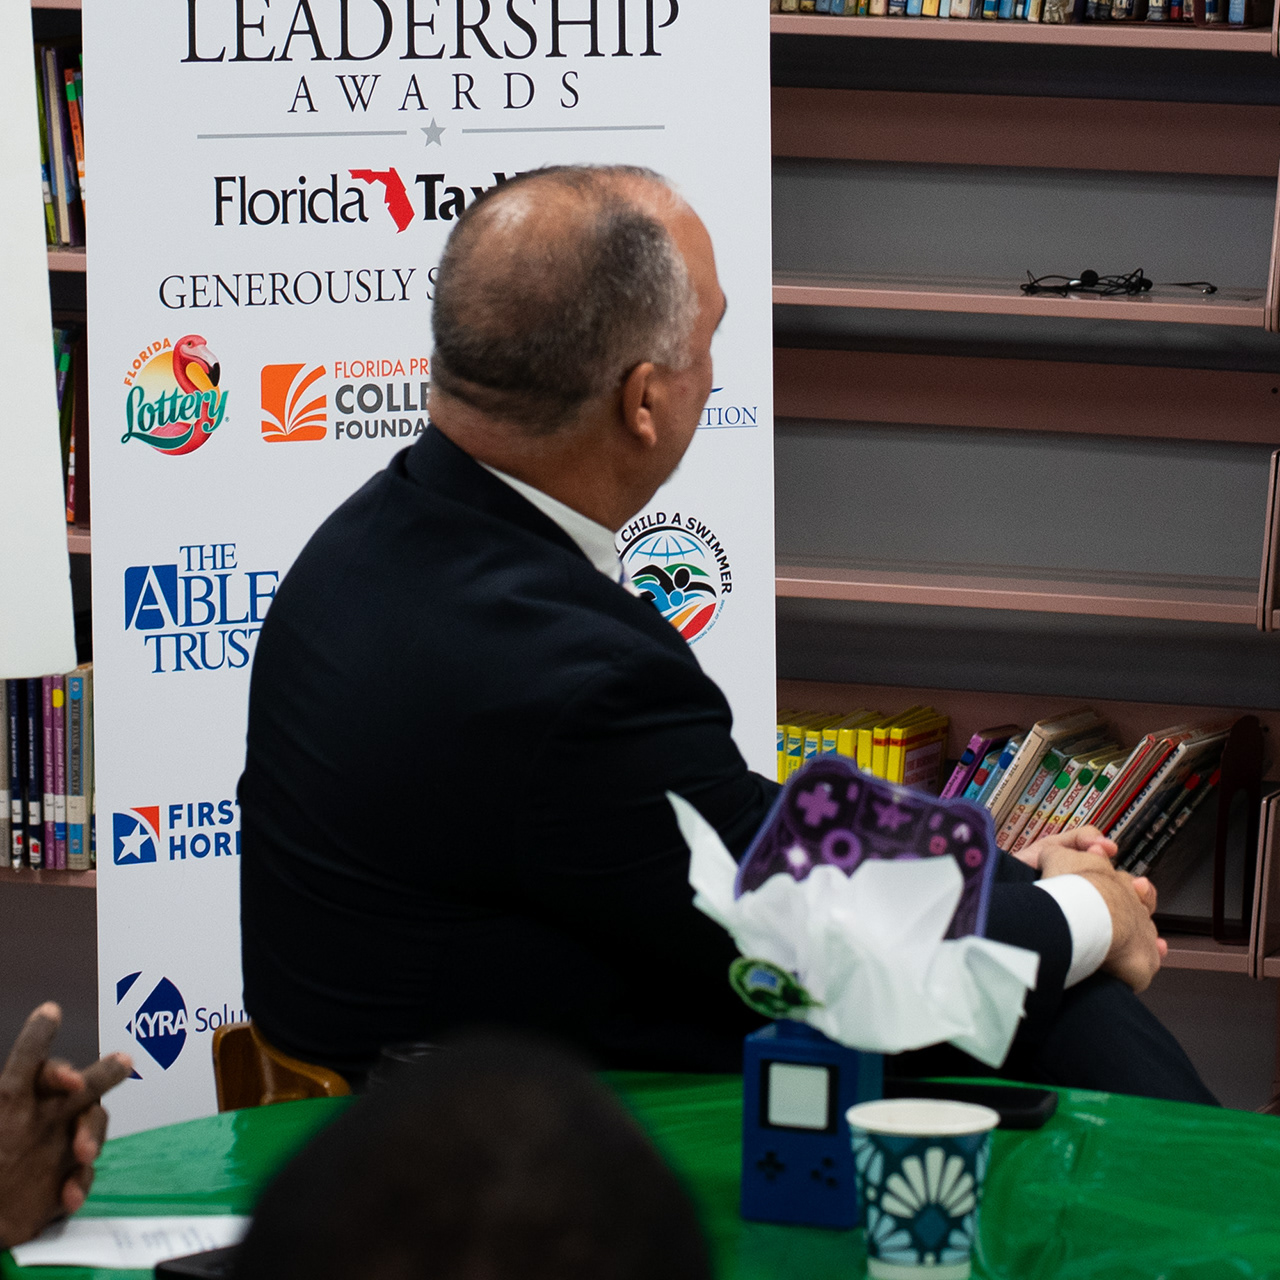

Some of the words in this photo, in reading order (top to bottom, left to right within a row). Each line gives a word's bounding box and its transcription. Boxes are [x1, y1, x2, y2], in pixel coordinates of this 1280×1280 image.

[287, 71, 581, 114] AWARDS
[213, 171, 369, 226] Florida
[159, 269, 416, 310] GENEROUSLY
[123, 337, 172, 386] FLORIDA
[334, 358, 406, 379] FLORIDA
[121, 385, 230, 449] Lottery
[335, 382, 430, 416] COLLE
[335, 416, 427, 441] FOUNDA
[179, 543, 238, 572] THE
[621, 512, 667, 543] CHILD
[671, 512, 682, 526] A
[685, 517, 733, 595] SWIMMER
[125, 566, 279, 631] ABLE
[169, 799, 241, 830] FIRS
[169, 831, 241, 861] HORI
[131, 1009, 188, 1039] KYRA
